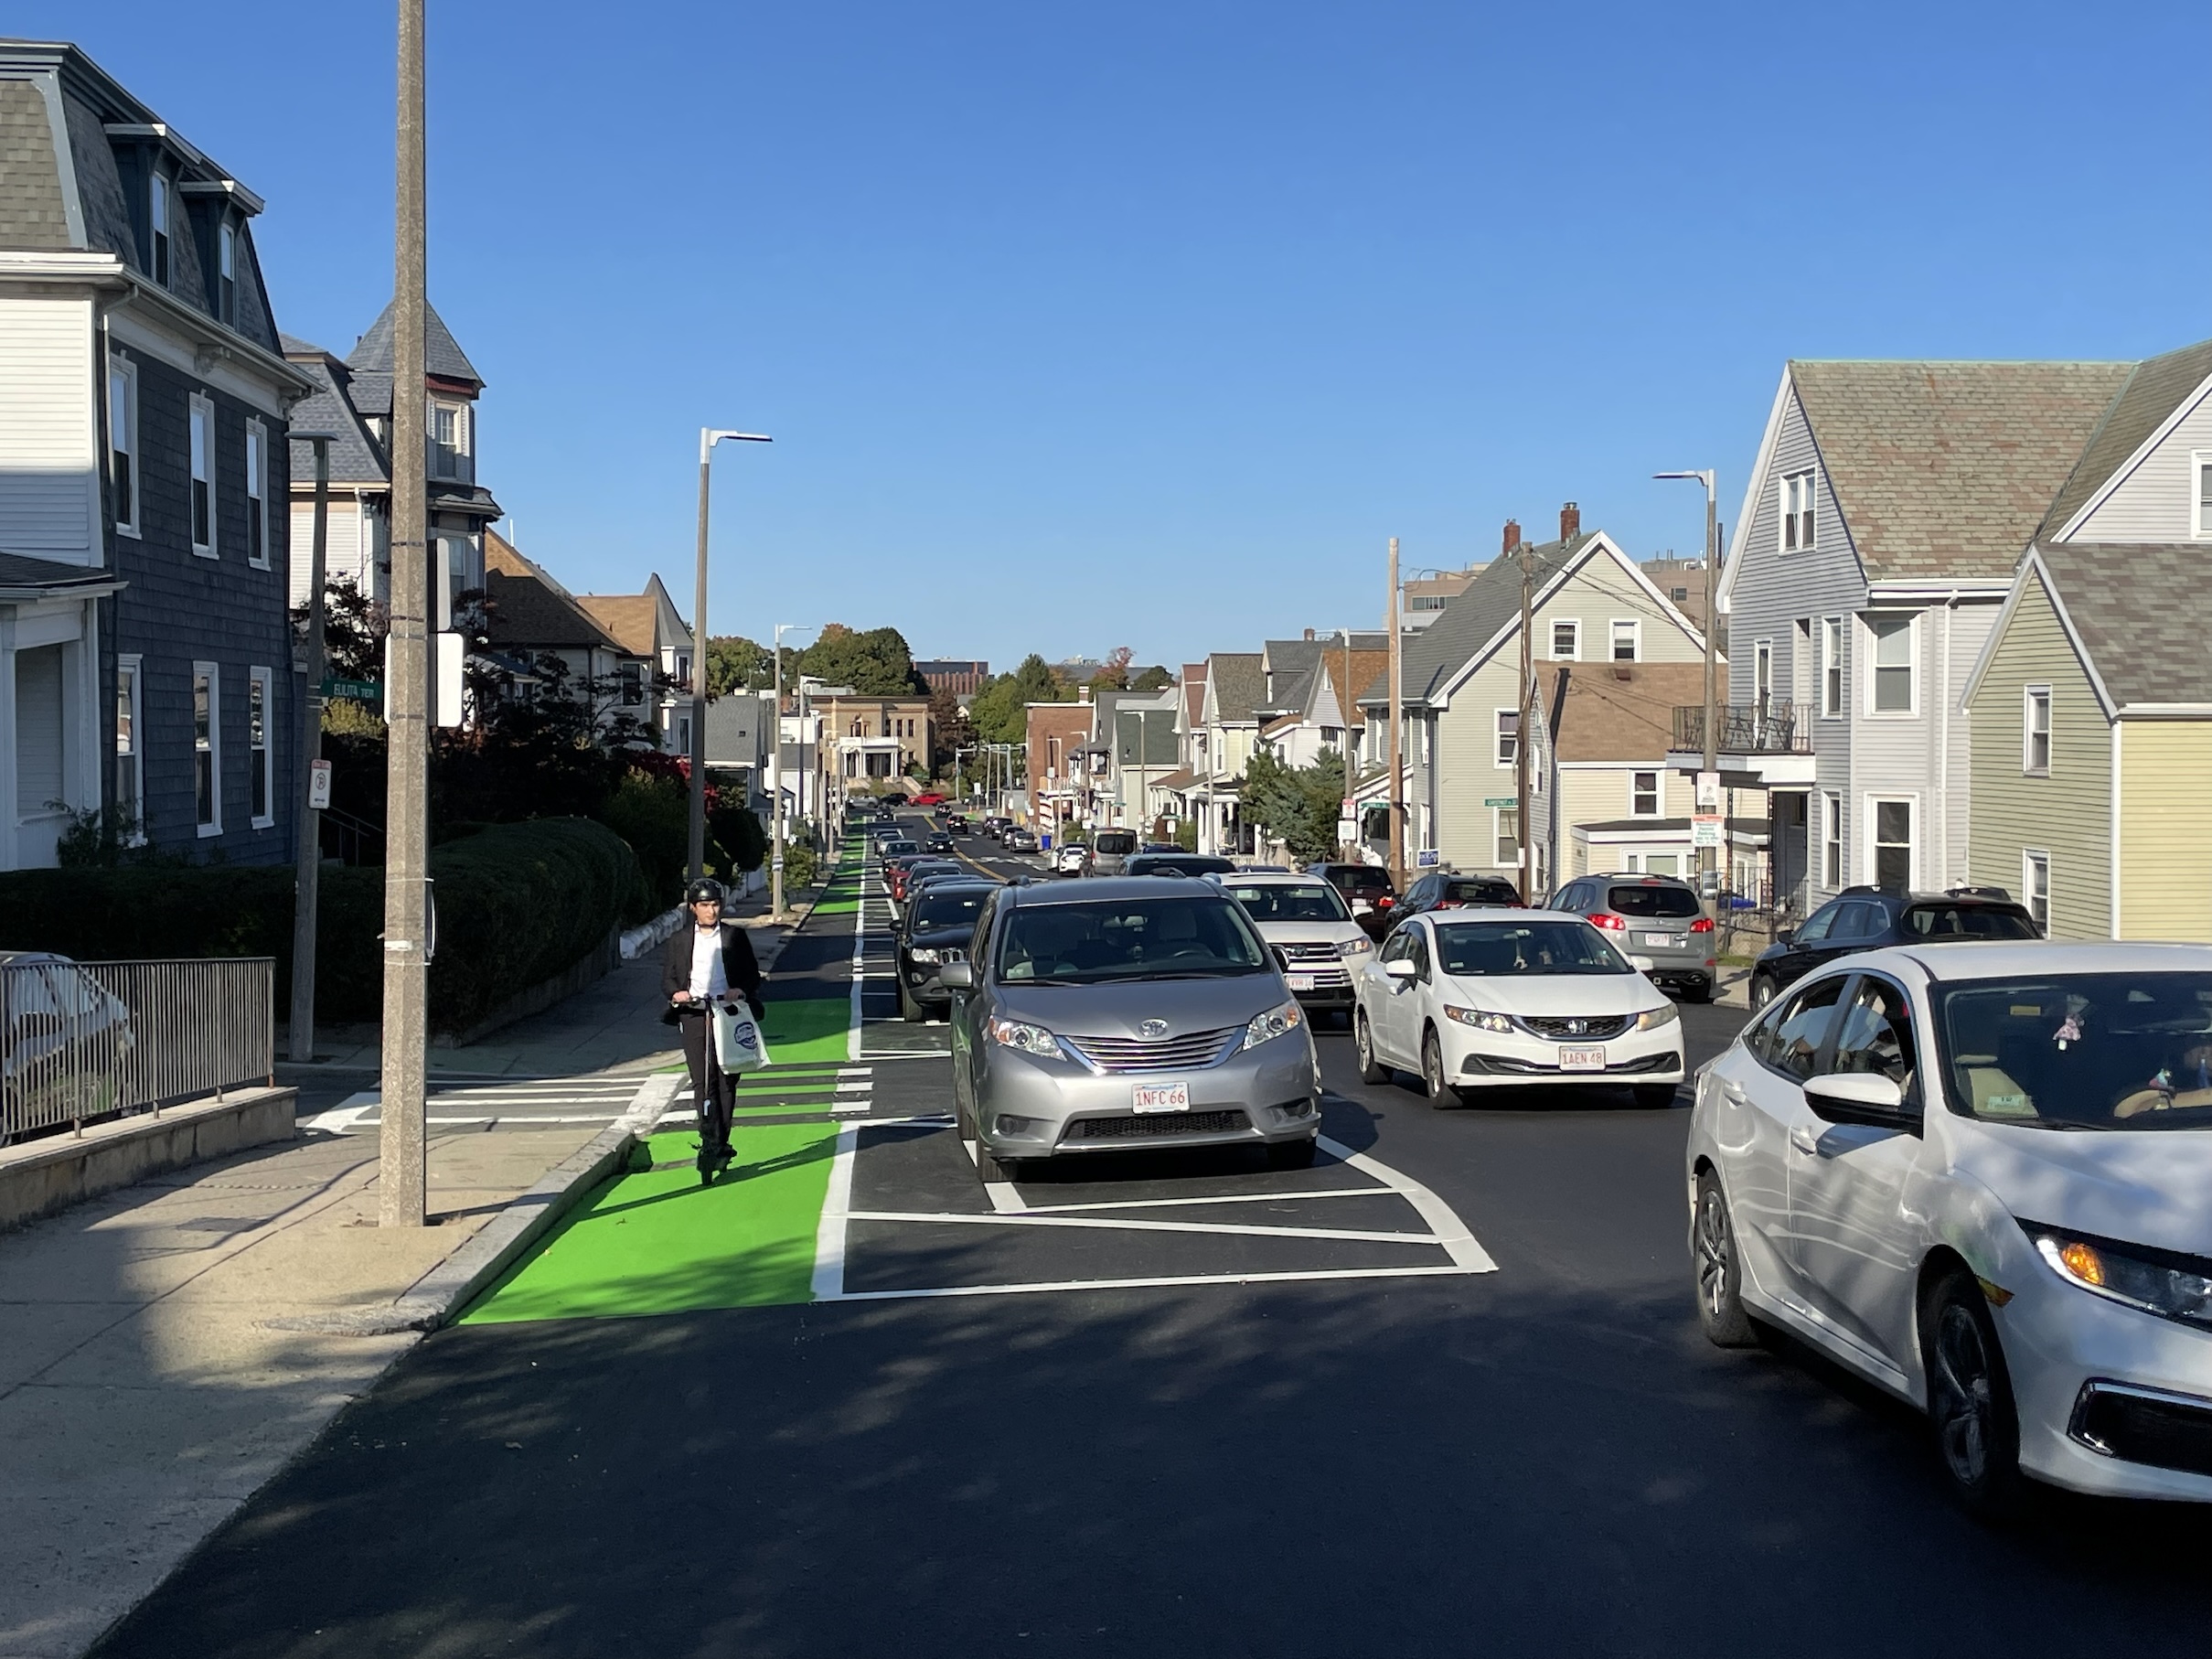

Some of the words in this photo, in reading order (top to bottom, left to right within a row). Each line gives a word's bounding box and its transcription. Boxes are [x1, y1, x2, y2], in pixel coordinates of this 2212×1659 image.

[1563, 1053, 1587, 1065] 1AEN
[1589, 1053, 1602, 1064] 48
[1136, 1090, 1166, 1106] 1NFC
[1170, 1090, 1185, 1104] 66
